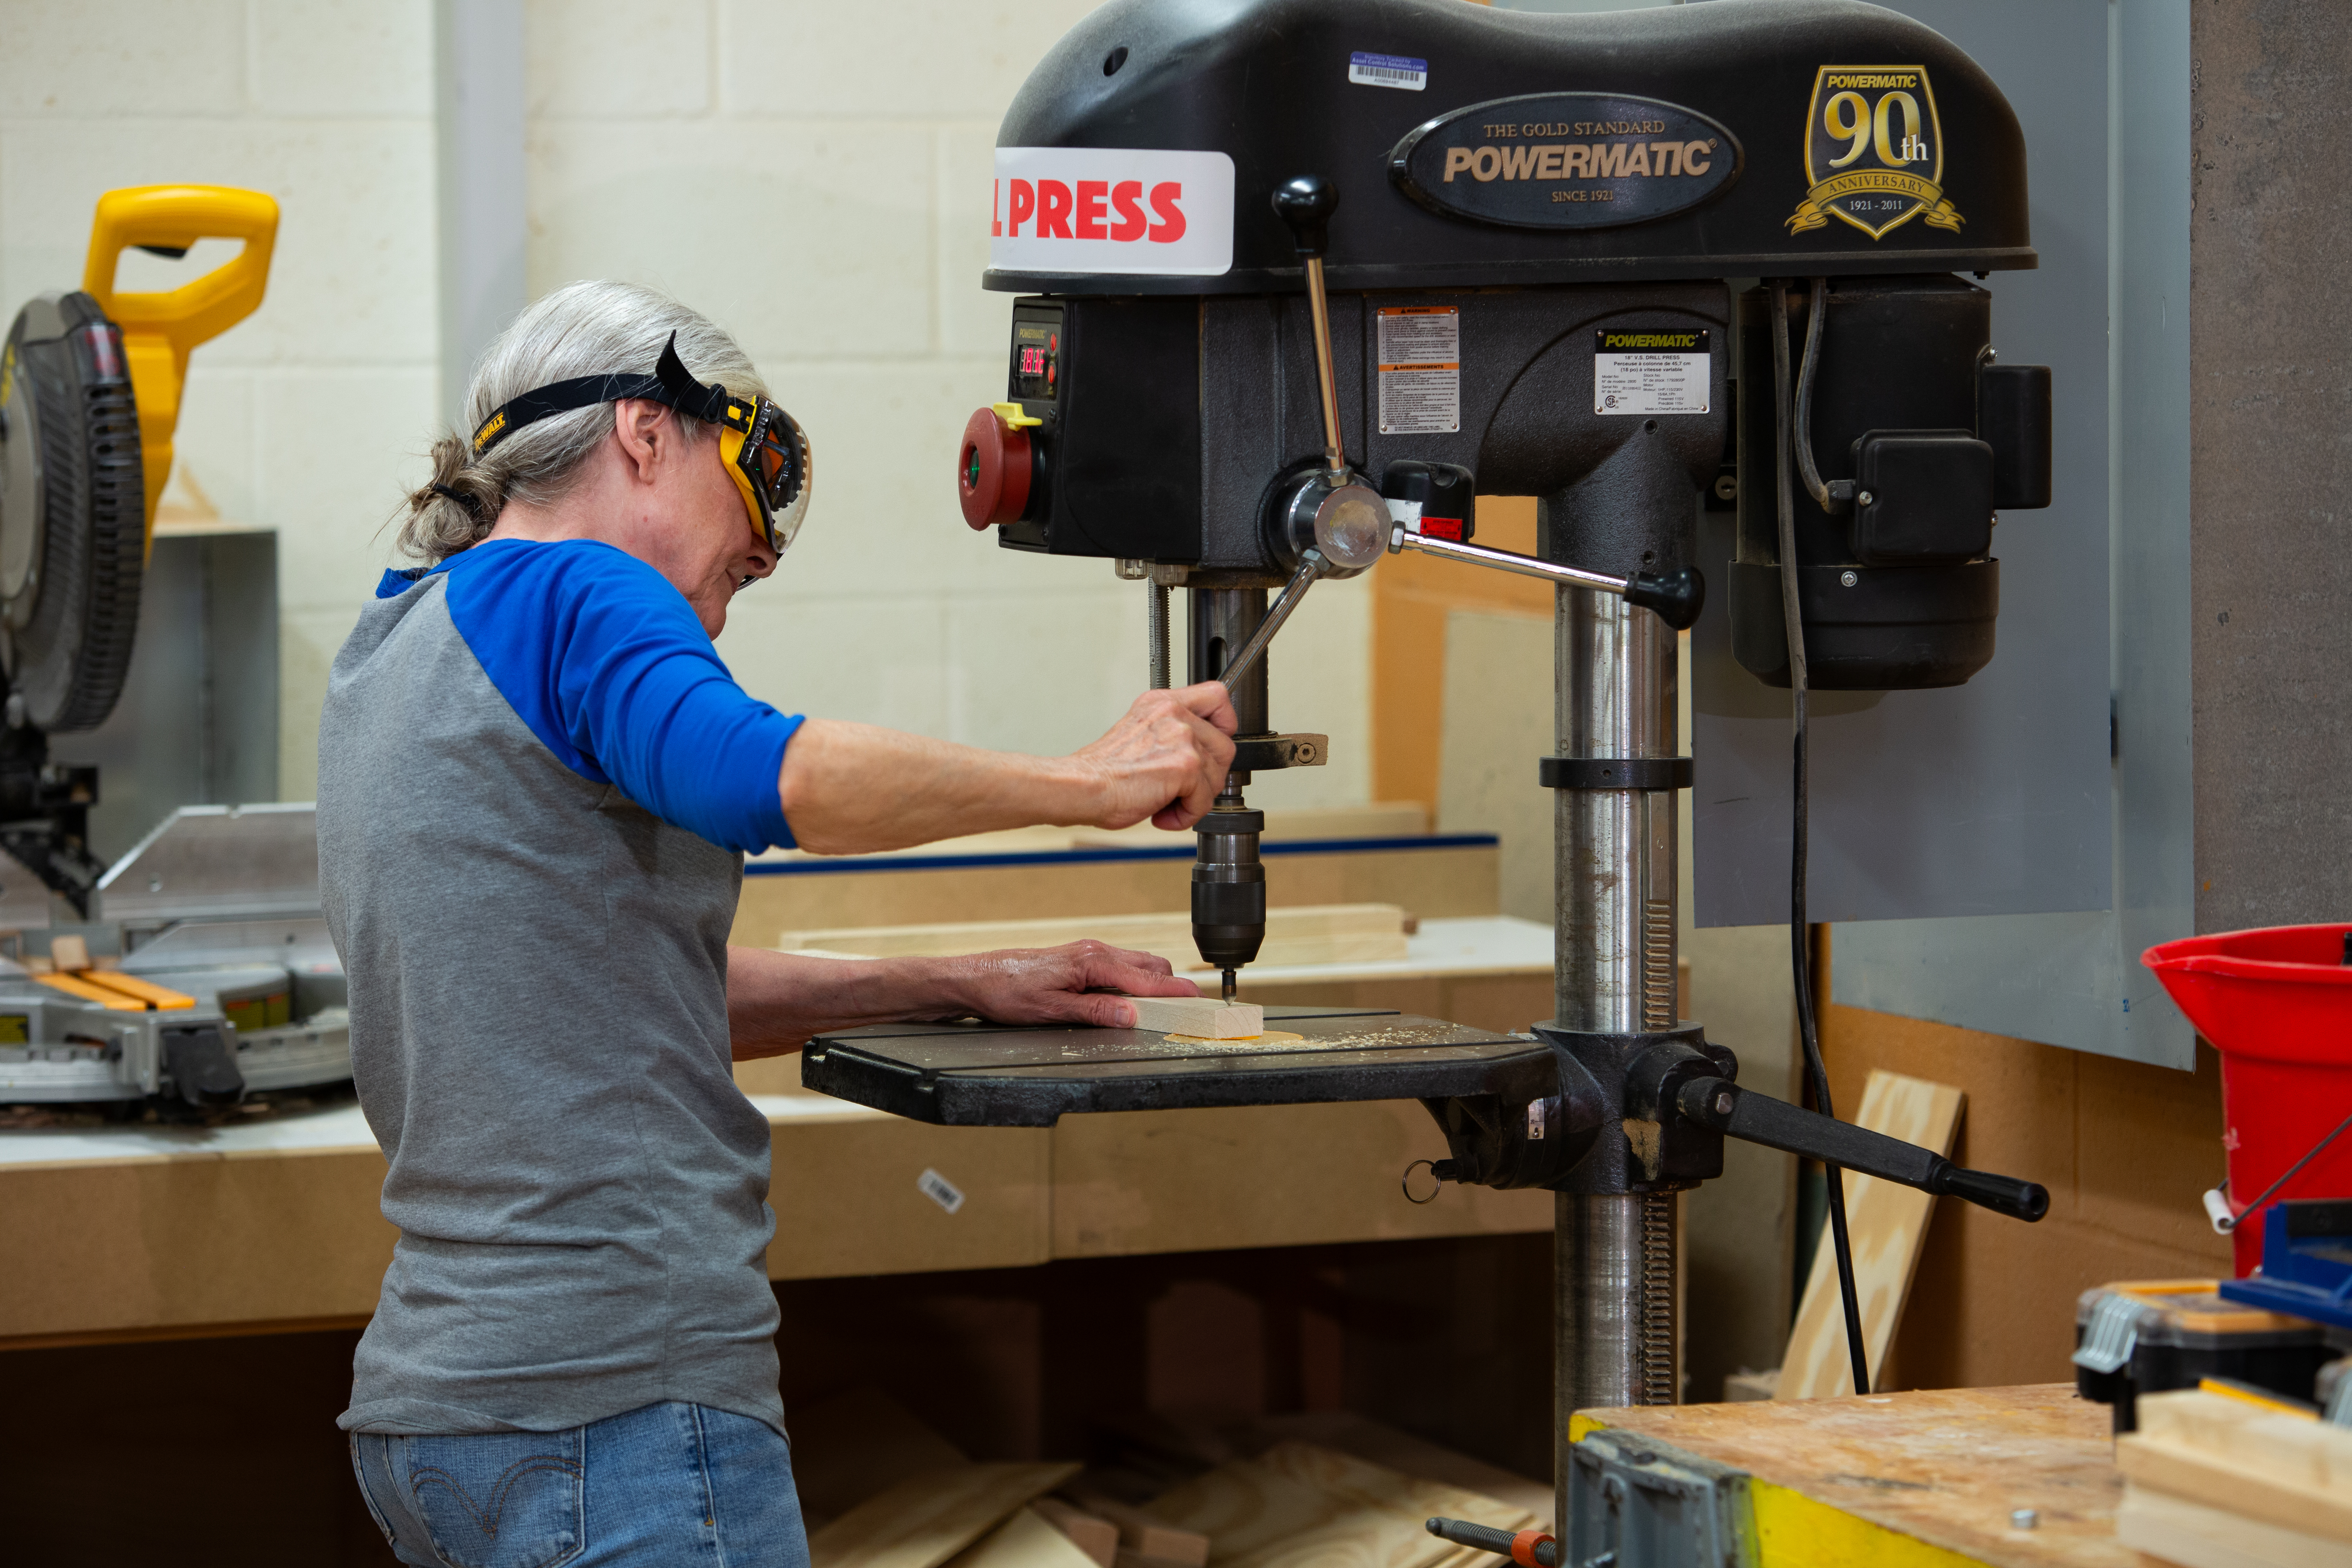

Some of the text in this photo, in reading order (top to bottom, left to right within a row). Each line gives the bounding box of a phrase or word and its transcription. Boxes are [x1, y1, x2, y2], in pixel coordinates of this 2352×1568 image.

[1827, 75, 1917, 88] POWERMATIC
[1484, 121, 1665, 138] THE GOLD STANDARD
[1443, 140, 1711, 183] POWERMATIC
[1829, 176, 1925, 194] ANNIVERSARY
[1552, 190, 1614, 202] SINCE 1921
[1009, 178, 1186, 244] PRESS
[1850, 200, 1871, 210] 1921
[1881, 200, 1902, 210] 2011
[1019, 328, 1045, 339] POWERMATIC
[1605, 334, 1695, 347] POWERMATIC
